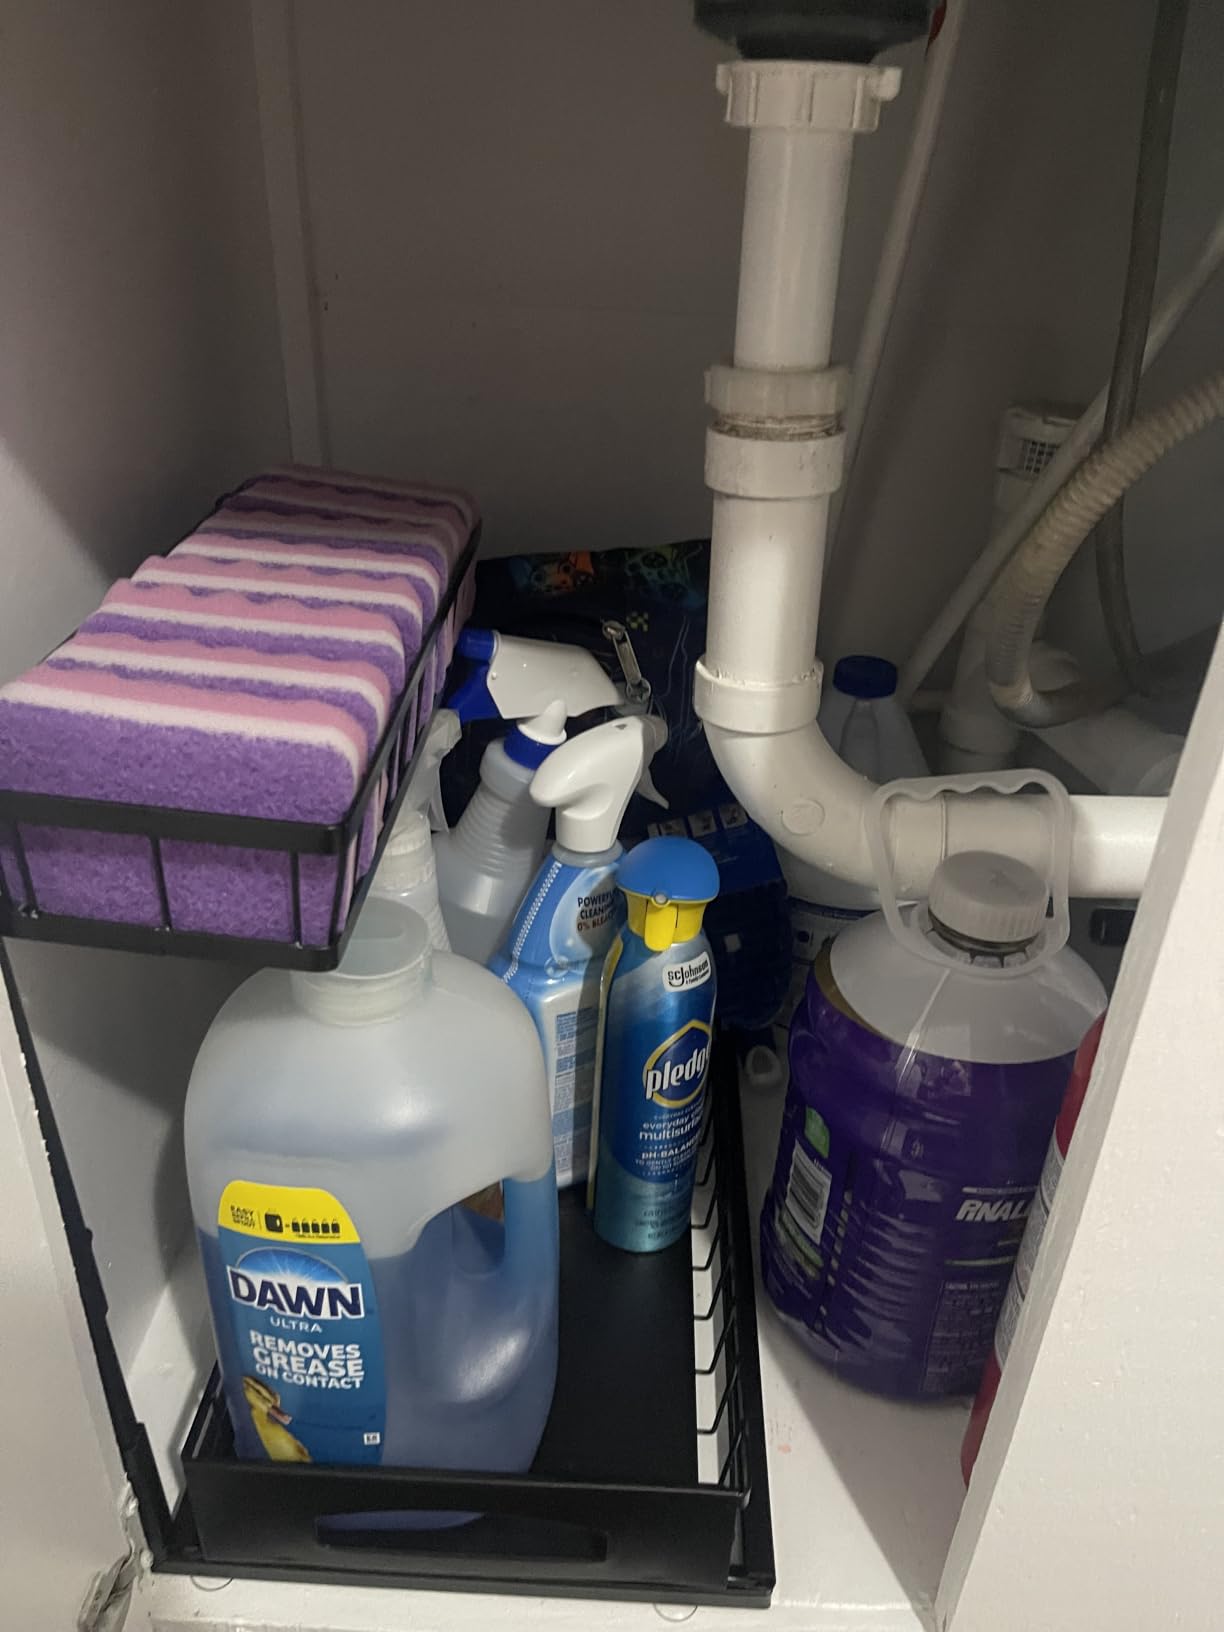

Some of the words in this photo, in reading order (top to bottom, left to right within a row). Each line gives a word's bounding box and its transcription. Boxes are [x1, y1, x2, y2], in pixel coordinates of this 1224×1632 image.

[642, 1114, 690, 1130] everyday
[228, 1267, 363, 1318] DAWN
[270, 1316, 323, 1333] ULTRA
[249, 1329, 361, 1360] REMOVES
[252, 1347, 364, 1378] GREASE
[255, 1363, 278, 1380] ON
[282, 1368, 364, 1390] CONTACT
